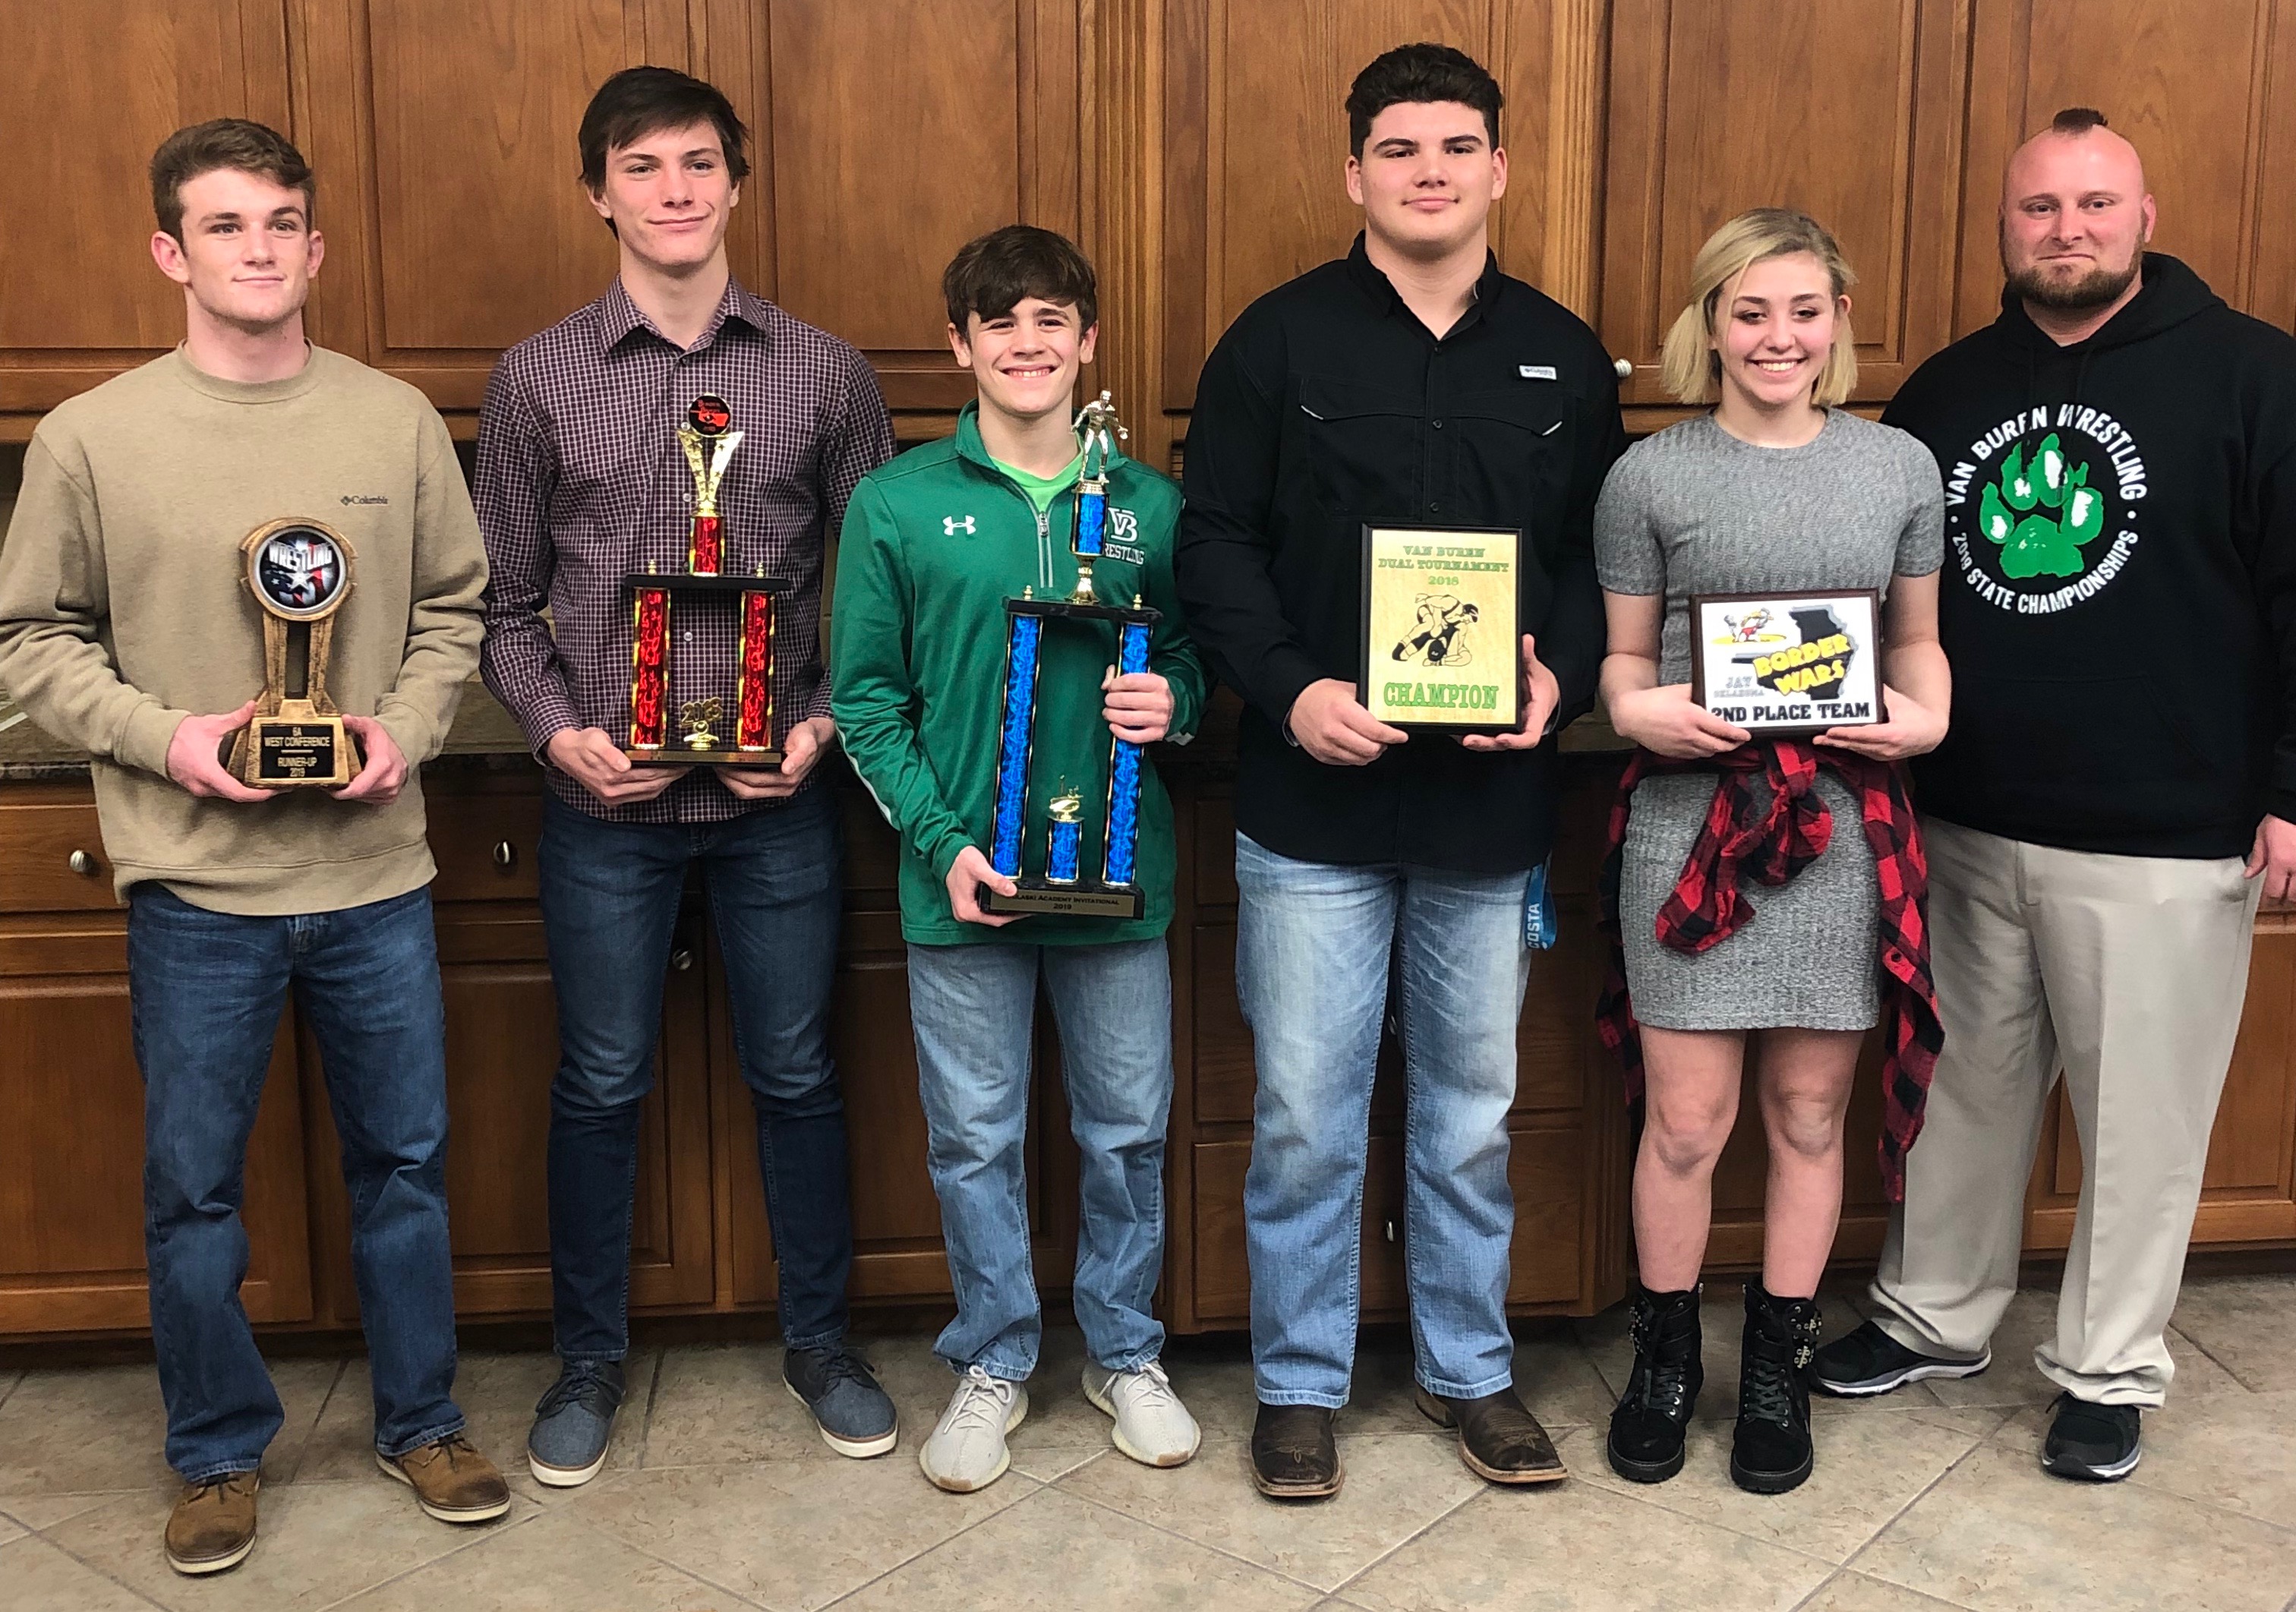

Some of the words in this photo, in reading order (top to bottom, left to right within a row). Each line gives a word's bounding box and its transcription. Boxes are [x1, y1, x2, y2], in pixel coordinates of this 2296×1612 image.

[1945, 461, 1977, 506] VAN
[2057, 403, 2147, 500] WRESTLING
[269, 541, 332, 573] WRESTLING
[1105, 543, 1144, 565] RESTLING
[1403, 546, 1433, 556] VAN
[1437, 547, 1485, 557] BUREN
[1378, 558, 1414, 569] DUAL
[1417, 560, 1509, 573] TOURNAMENT
[1952, 532, 1973, 570] 2019
[1966, 568, 2016, 610] STATE
[2017, 530, 2138, 614] CHAMPIONSHIPS
[1428, 576, 1459, 585] 2018
[1752, 633, 1850, 678] BORDER
[1774, 659, 1846, 696] WARS
[1383, 682, 1499, 709] CHAMPION
[1711, 707, 1747, 722] 2ND
[1752, 705, 1811, 721] PLACE
[1817, 702, 1870, 719] TEAM
[264, 737, 284, 746] WEST
[285, 737, 330, 746] CONFERENCE
[292, 727, 302, 737] 6A
[278, 757, 317, 767] RUNNER-UP
[1039, 895, 1071, 904] ACADEMY
[1074, 897, 1120, 905] INVITATIONAL
[1527, 903, 1540, 948] COSTA
